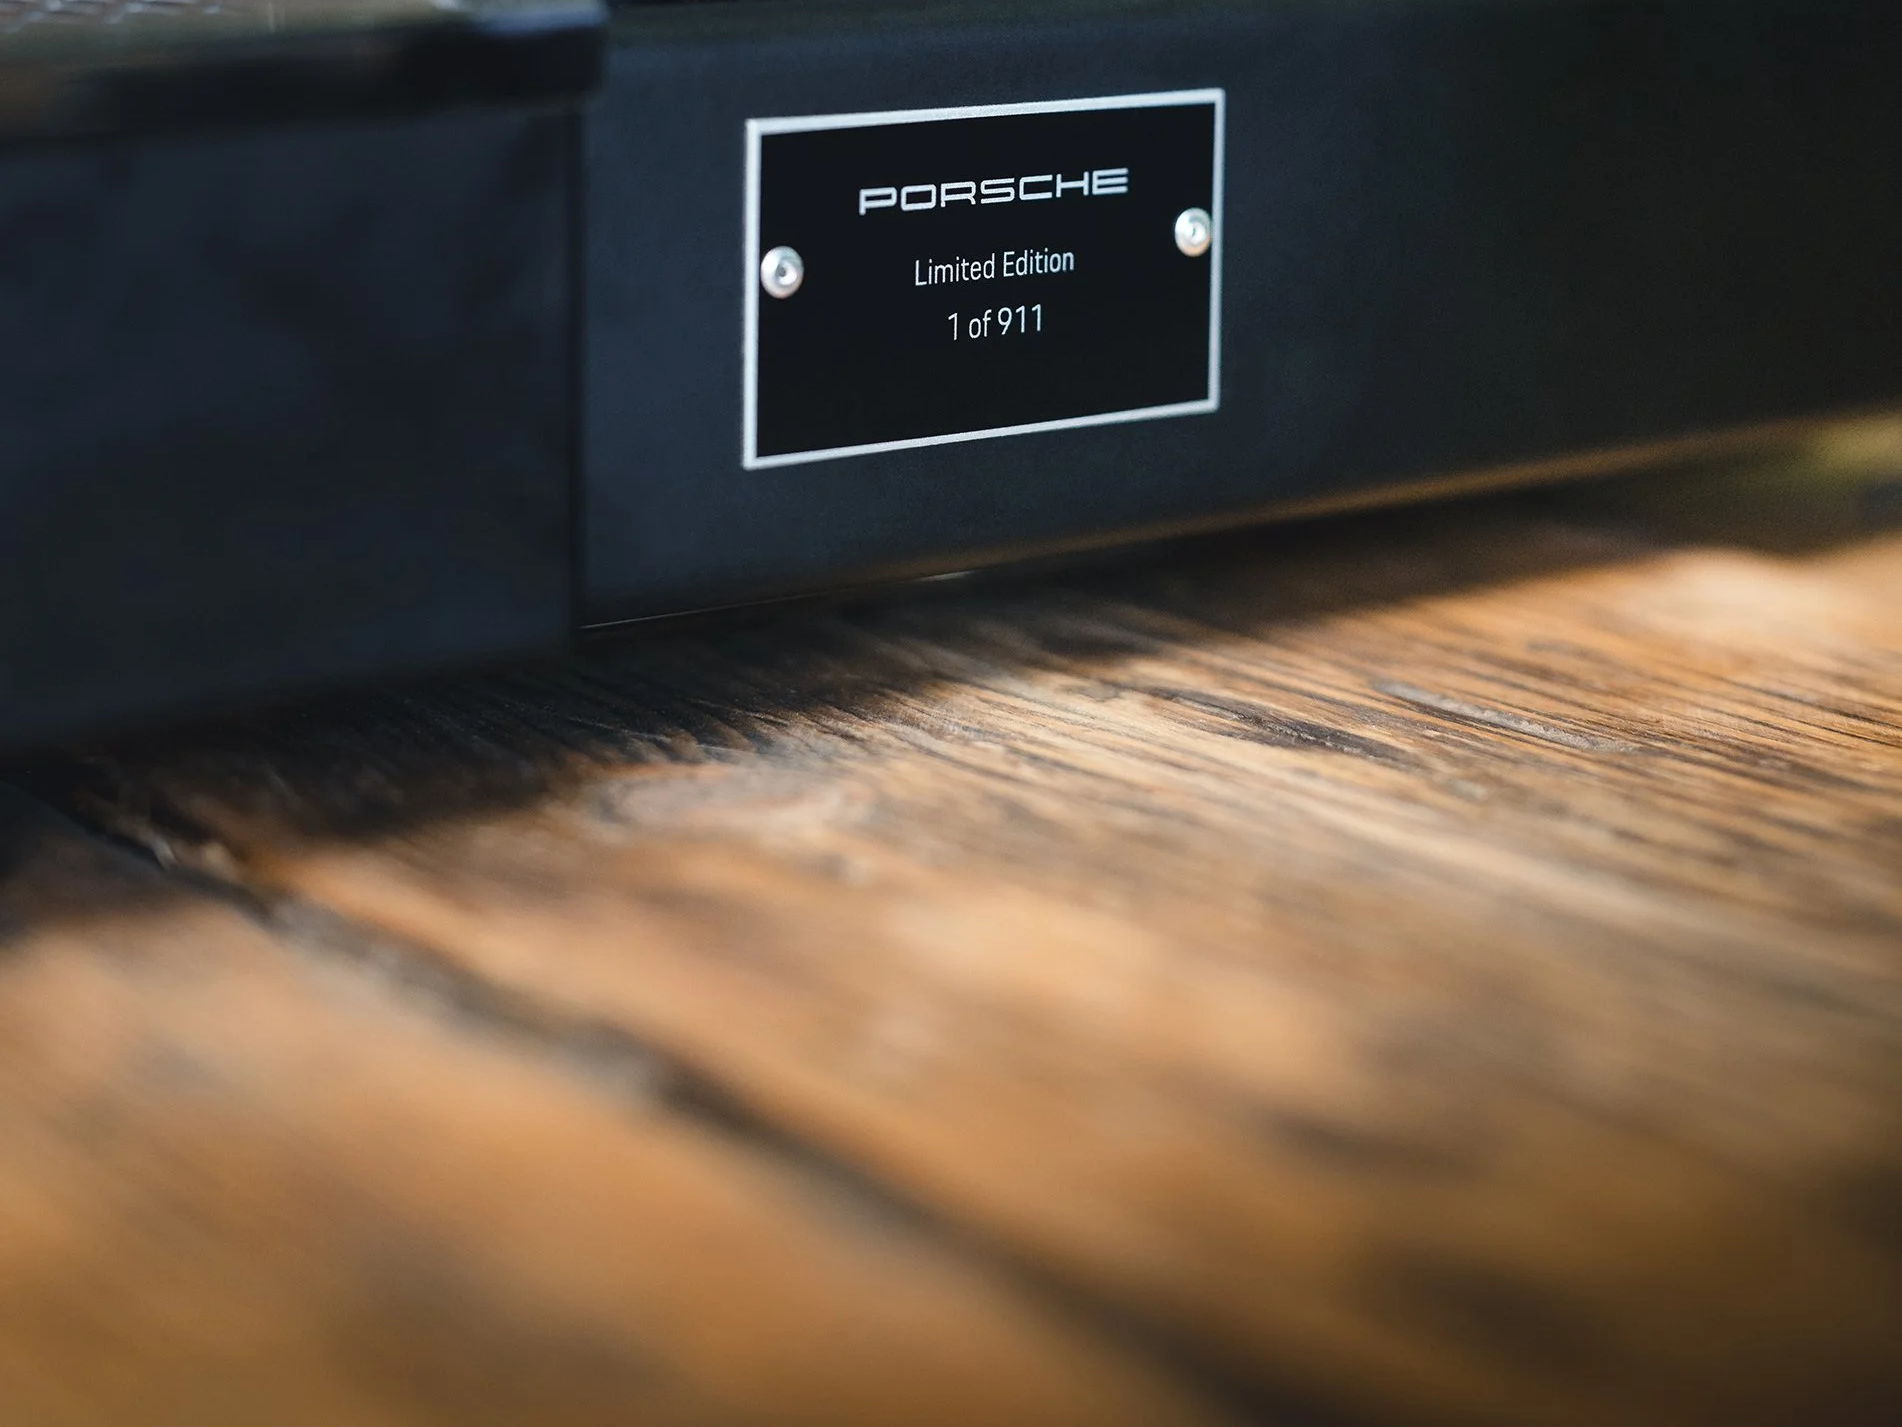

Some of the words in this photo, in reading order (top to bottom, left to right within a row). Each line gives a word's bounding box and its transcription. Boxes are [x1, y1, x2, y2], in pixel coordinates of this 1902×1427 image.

[858, 167, 1129, 215] PORSCHE
[914, 252, 996, 287] Limited
[1002, 247, 1075, 278] Edition
[947, 312, 960, 341] 1
[968, 309, 992, 339] of
[997, 303, 1043, 336] 911
